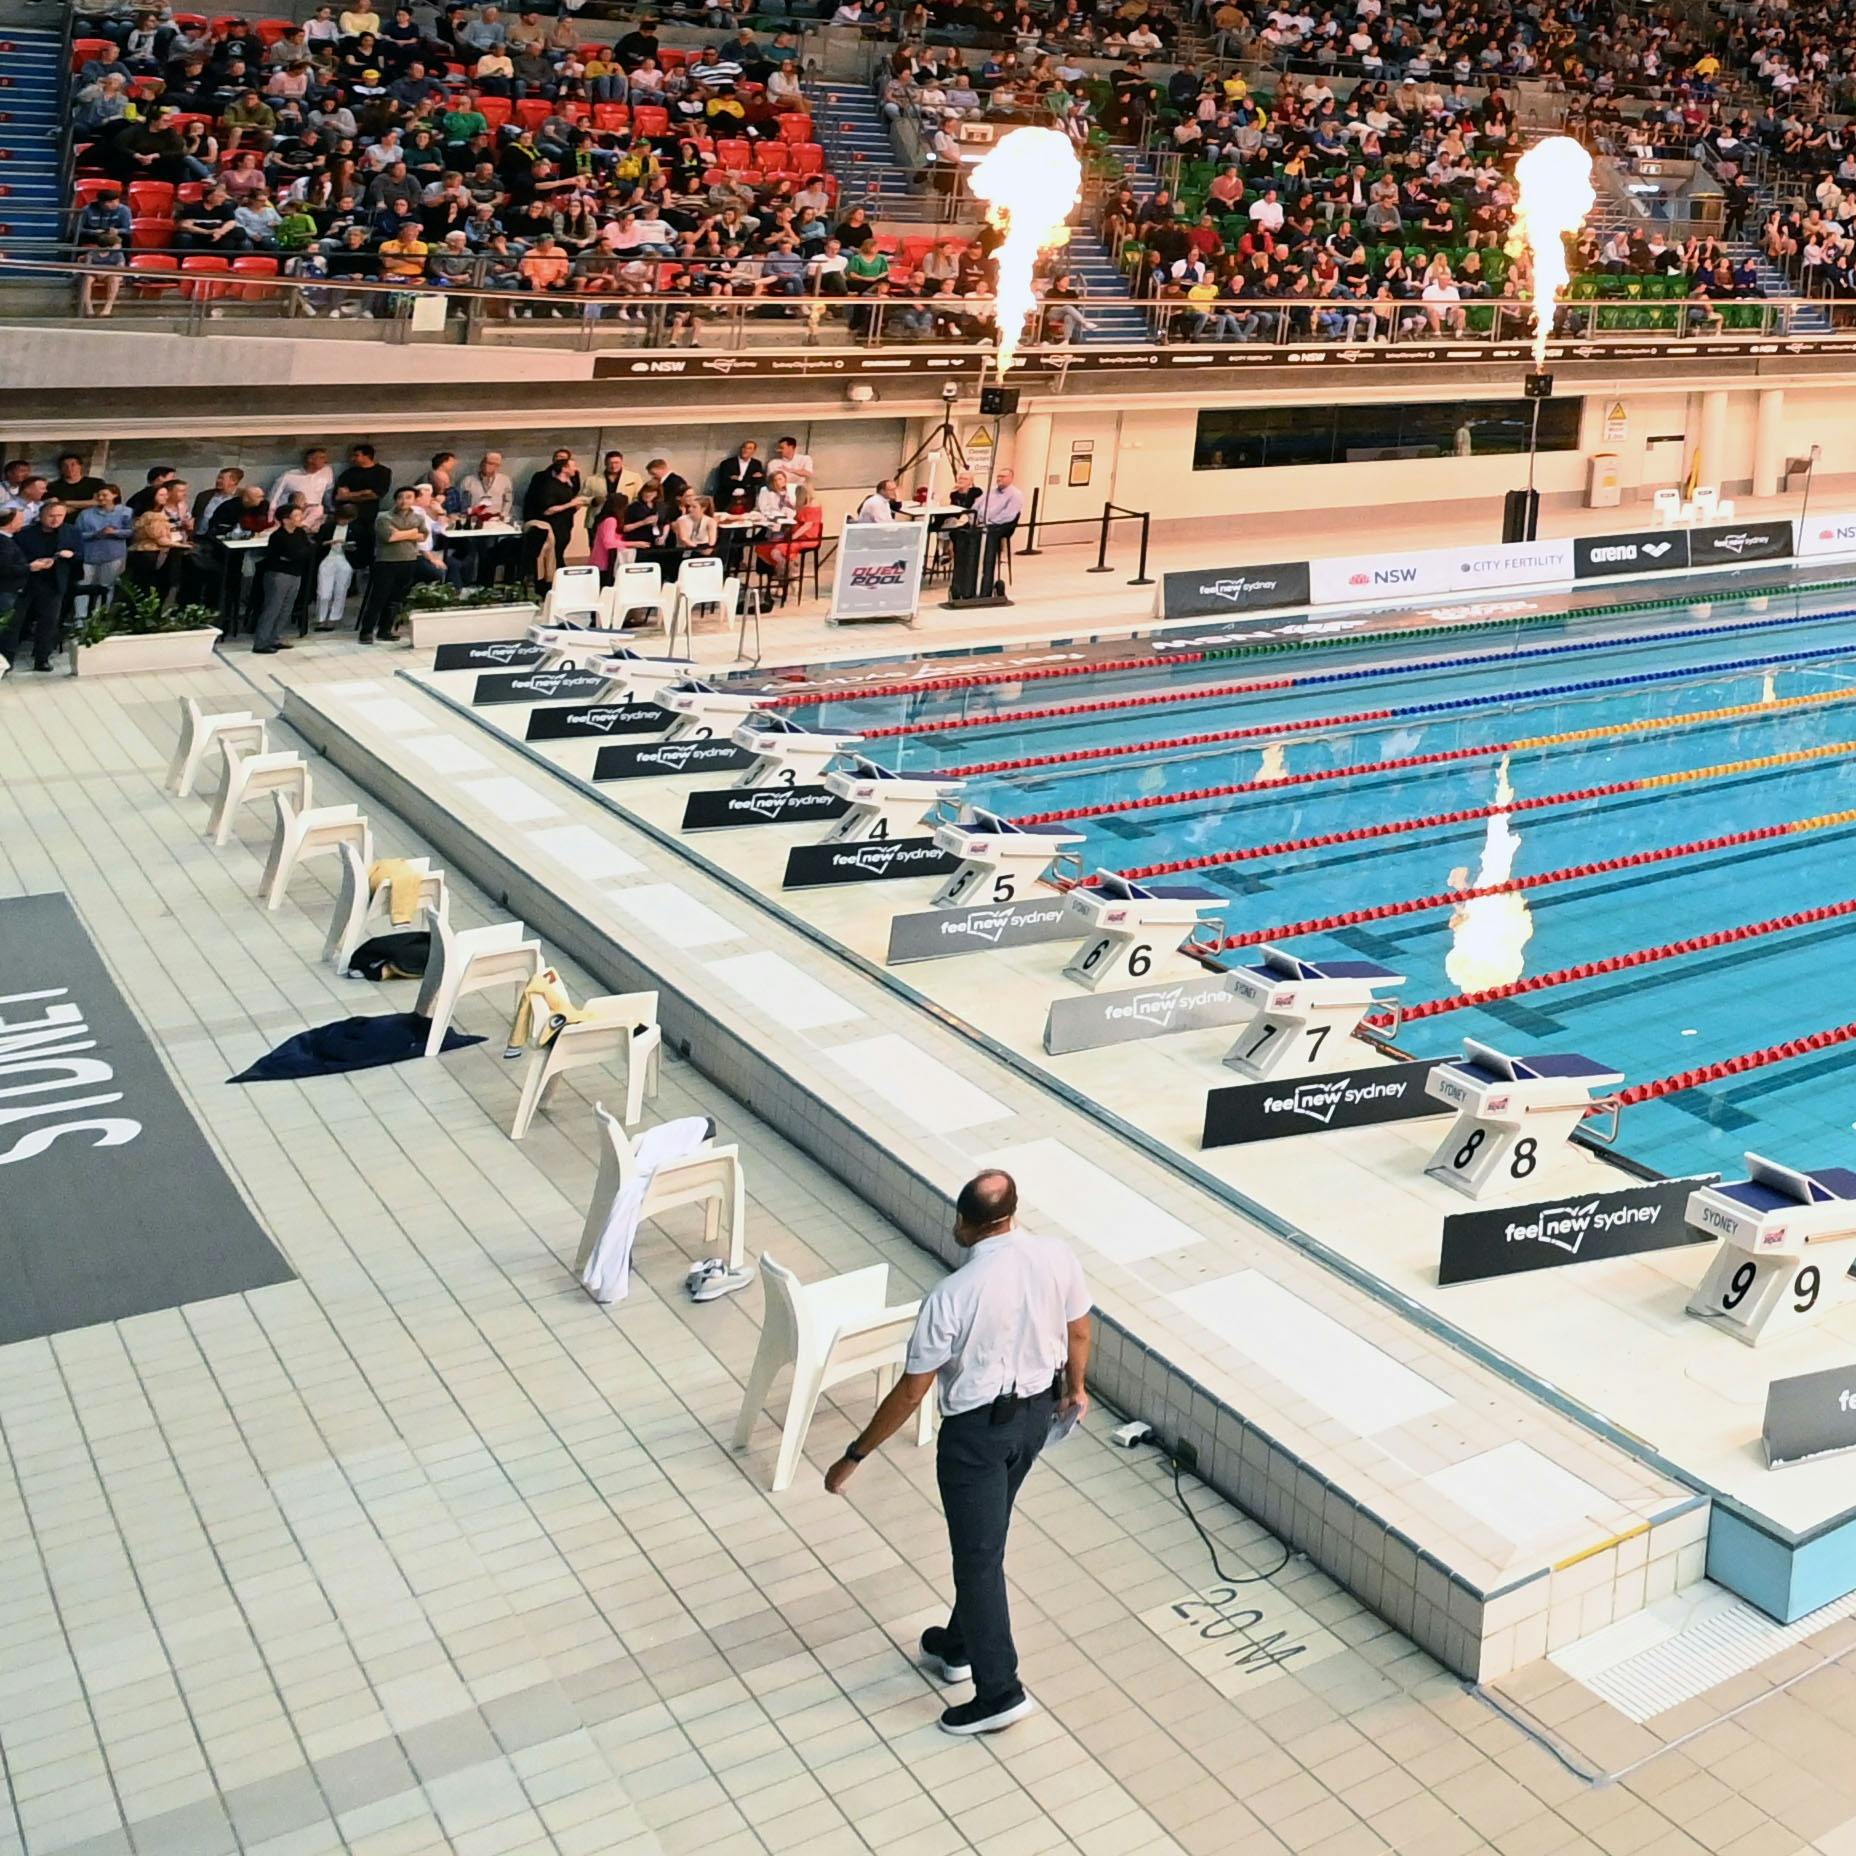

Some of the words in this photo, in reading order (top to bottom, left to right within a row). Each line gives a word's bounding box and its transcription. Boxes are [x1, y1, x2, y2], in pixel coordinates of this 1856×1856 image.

[650, 361, 687, 372] NSW
[1472, 559, 1502, 574] CITY
[1504, 554, 1564, 571] FERTILITY
[1590, 544, 1637, 563] arena
[850, 574, 905, 587] POOL
[1374, 567, 1418, 585] NSW
[511, 677, 533, 690] feel
[533, 675, 561, 689] new
[561, 675, 602, 688] sydney
[566, 712, 589, 725] feel
[590, 710, 619, 723] new
[620, 709, 662, 722] sydney
[636, 750, 659, 763] feel
[660, 748, 692, 762] new
[692, 746, 738, 761] sydney
[778, 768, 796, 786] 3
[728, 797, 753, 811] feel
[754, 795, 786, 809] new
[787, 793, 836, 808] sydney
[868, 817, 890, 841] 4
[832, 851, 860, 867] feel
[861, 851, 895, 864] new
[896, 846, 946, 863] sydney
[948, 870, 975, 899] 5
[992, 873, 1016, 904] 5
[940, 917, 971, 936] feel
[972, 915, 1009, 931] new
[1009, 908, 1065, 929] sydney
[1082, 939, 1111, 971] 6
[1128, 944, 1153, 977] 6
[1104, 1001, 1137, 1020] feel
[1138, 997, 1178, 1015] new
[1178, 990, 1235, 1011] sydney
[1246, 1023, 1278, 1059] 7
[1305, 1024, 1333, 1063] 7
[1262, 1093, 1300, 1114] feel
[1301, 1090, 1343, 1109] new
[1344, 1080, 1408, 1104] sydney
[1438, 1079, 1467, 1104] SYDNEY
[1453, 1128, 1486, 1170] 8
[1509, 1136, 1539, 1180] 8
[1504, 1217, 1543, 1244] feel
[1546, 1214, 1592, 1237] new
[1592, 1203, 1662, 1232] sydney
[1701, 1206, 1739, 1237] SYDNEY
[1721, 1260, 1758, 1311] 9
[1793, 1264, 1821, 1313] 9
[1171, 1587, 1264, 1641] 2.0
[1225, 1630, 1307, 1675] M
